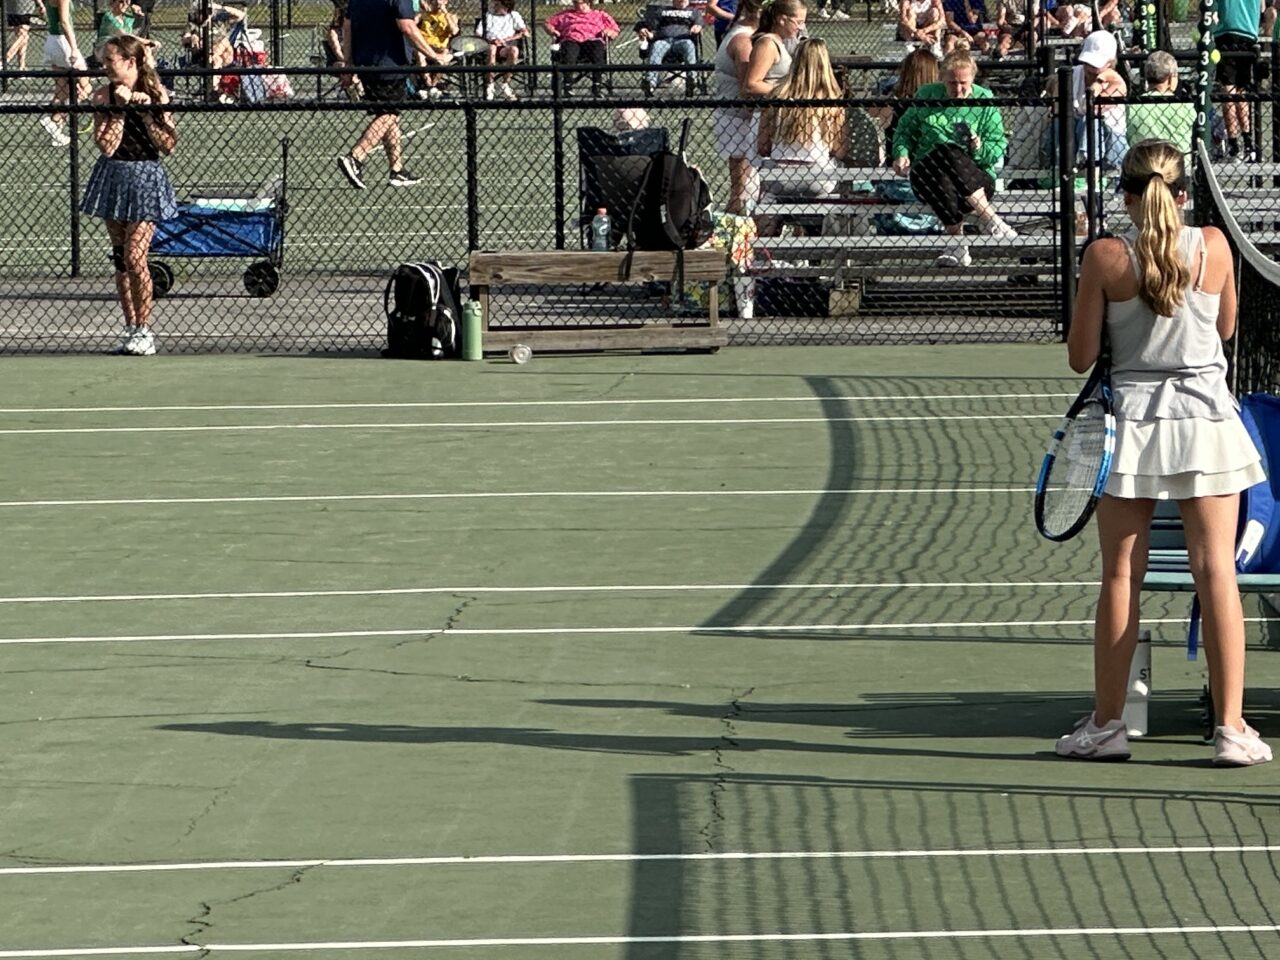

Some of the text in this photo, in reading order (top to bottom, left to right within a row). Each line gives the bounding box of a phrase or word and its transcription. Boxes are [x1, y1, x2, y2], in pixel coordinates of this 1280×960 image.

[1141, 4, 1148, 16] 3
[1141, 19, 1148, 30] 2
[1203, 11, 1213, 27] 5
[1141, 34, 1147, 45] 1
[1201, 30, 1211, 46] 4
[1200, 50, 1210, 66] 3
[1199, 70, 1209, 86] 2
[1199, 90, 1206, 106] 1
